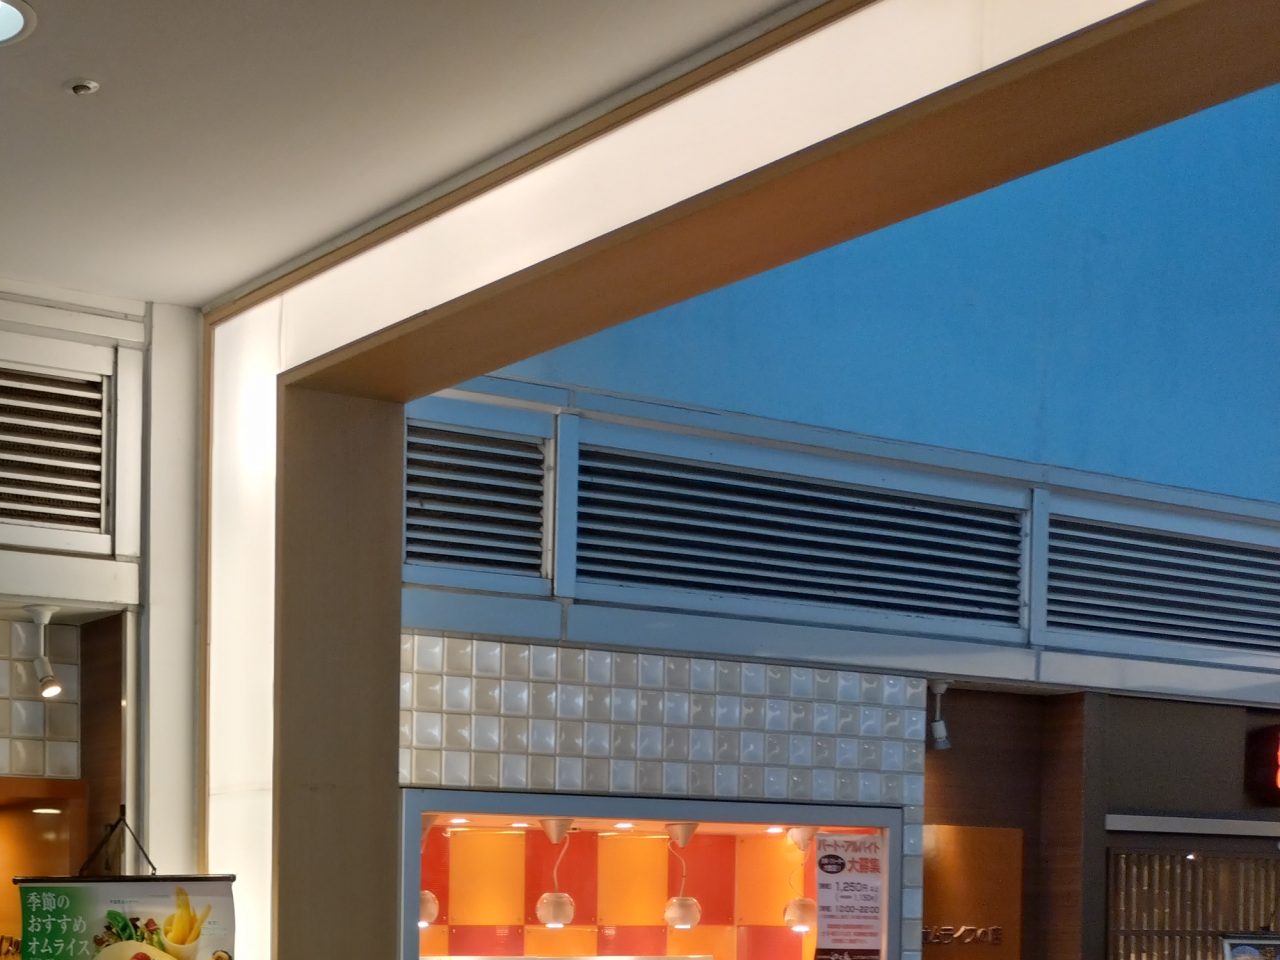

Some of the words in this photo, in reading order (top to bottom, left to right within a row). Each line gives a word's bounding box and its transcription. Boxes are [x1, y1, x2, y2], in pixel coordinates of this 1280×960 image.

[27, 892, 70, 911] 季節の
[28, 915, 86, 934] おすすめ
[28, 938, 90, 957] オムライス
